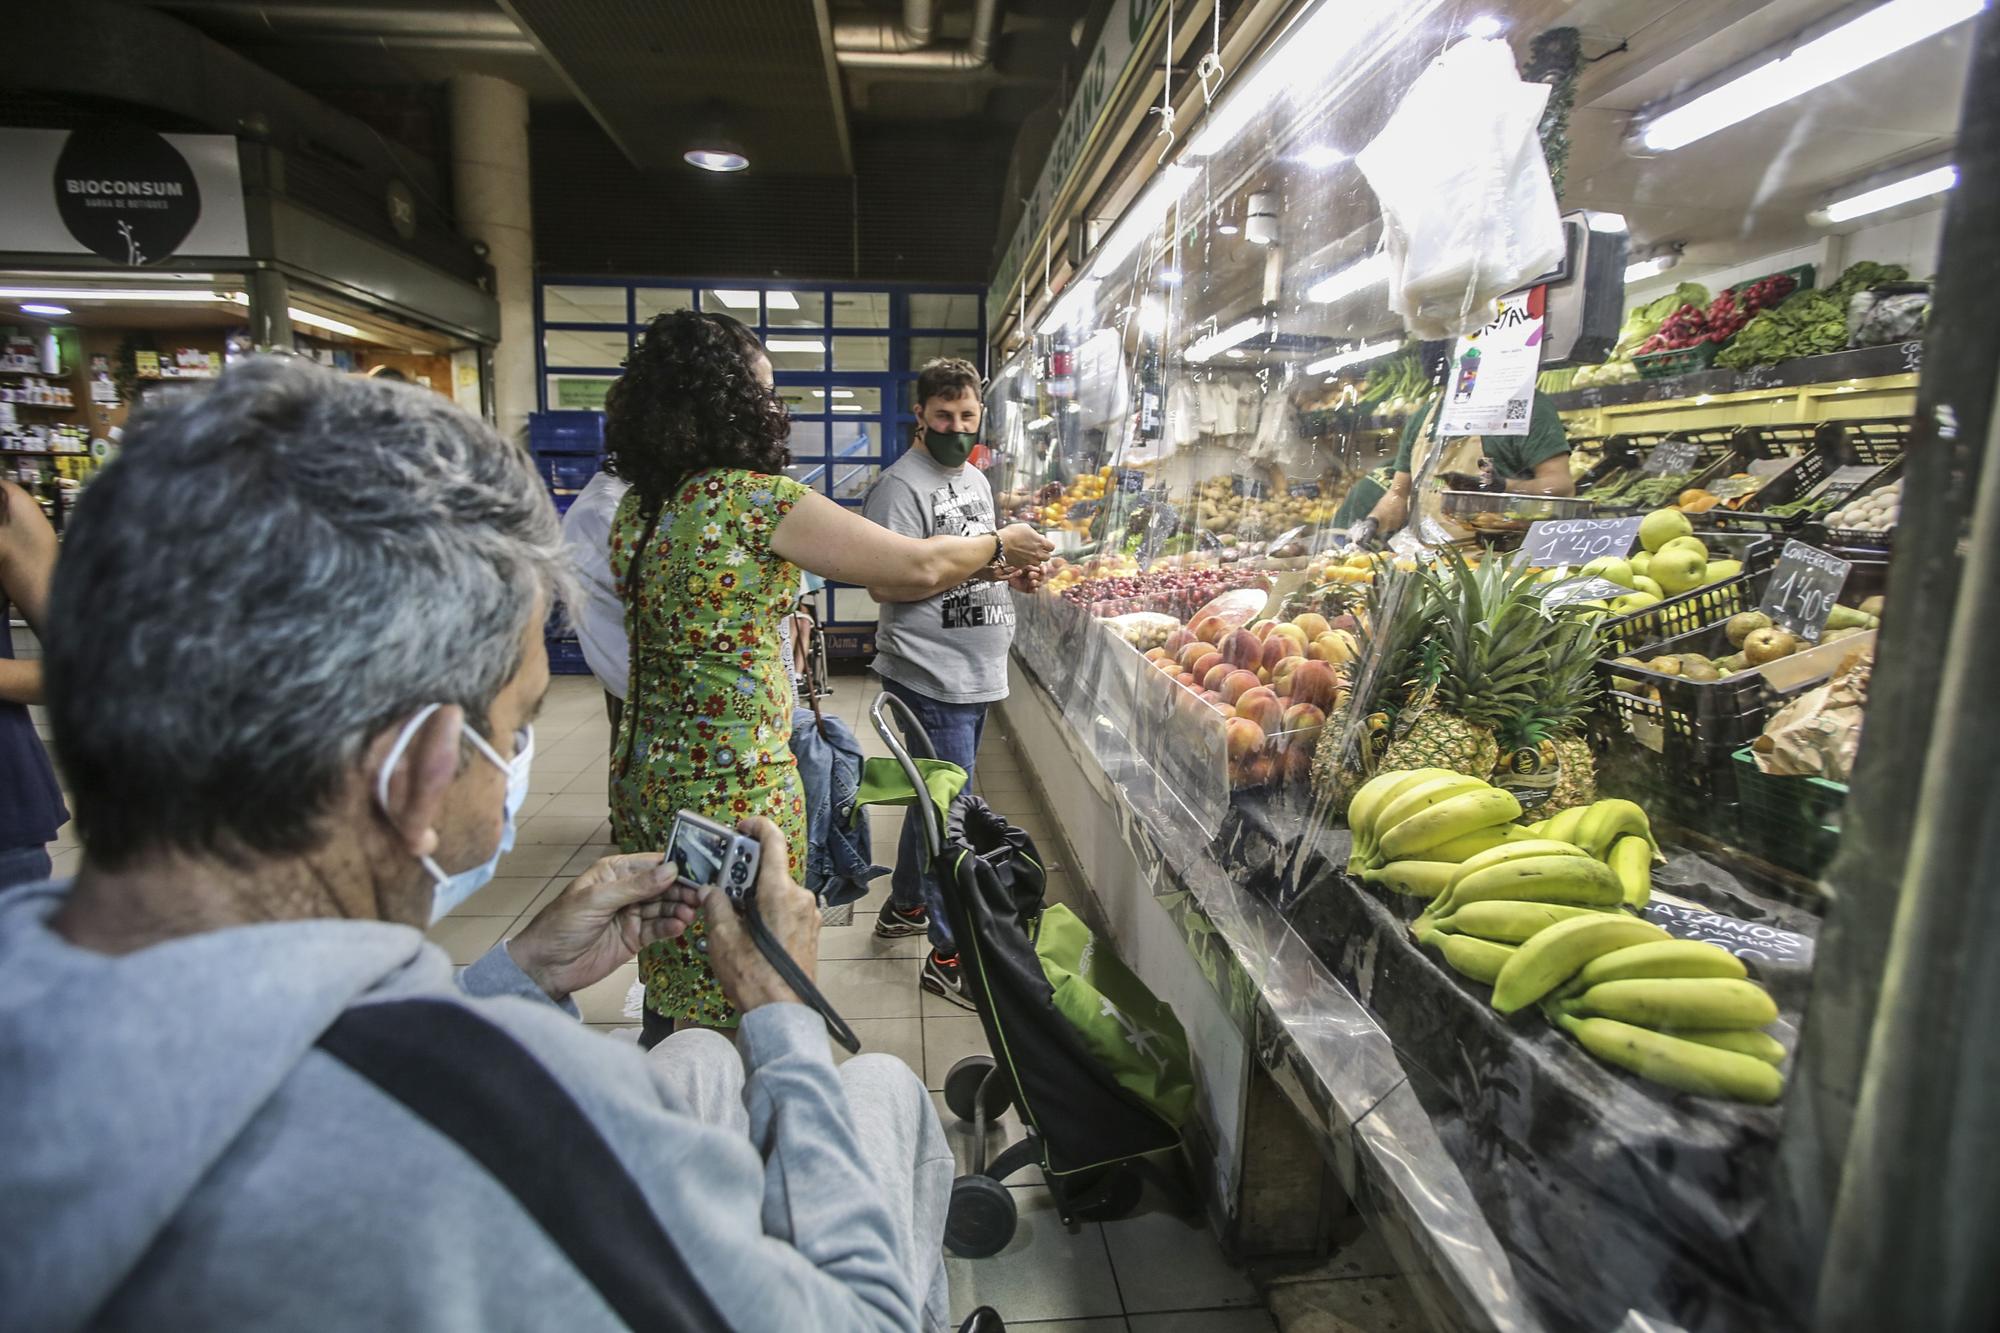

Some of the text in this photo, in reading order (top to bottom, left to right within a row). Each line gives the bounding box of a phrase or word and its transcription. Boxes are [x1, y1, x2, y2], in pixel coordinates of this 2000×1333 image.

[66, 179, 183, 196] BIOCONSUM
[1539, 519, 1626, 536] GOLDEN
[942, 606, 984, 629] LIKE
[1671, 919, 1795, 955] CANARIOS
